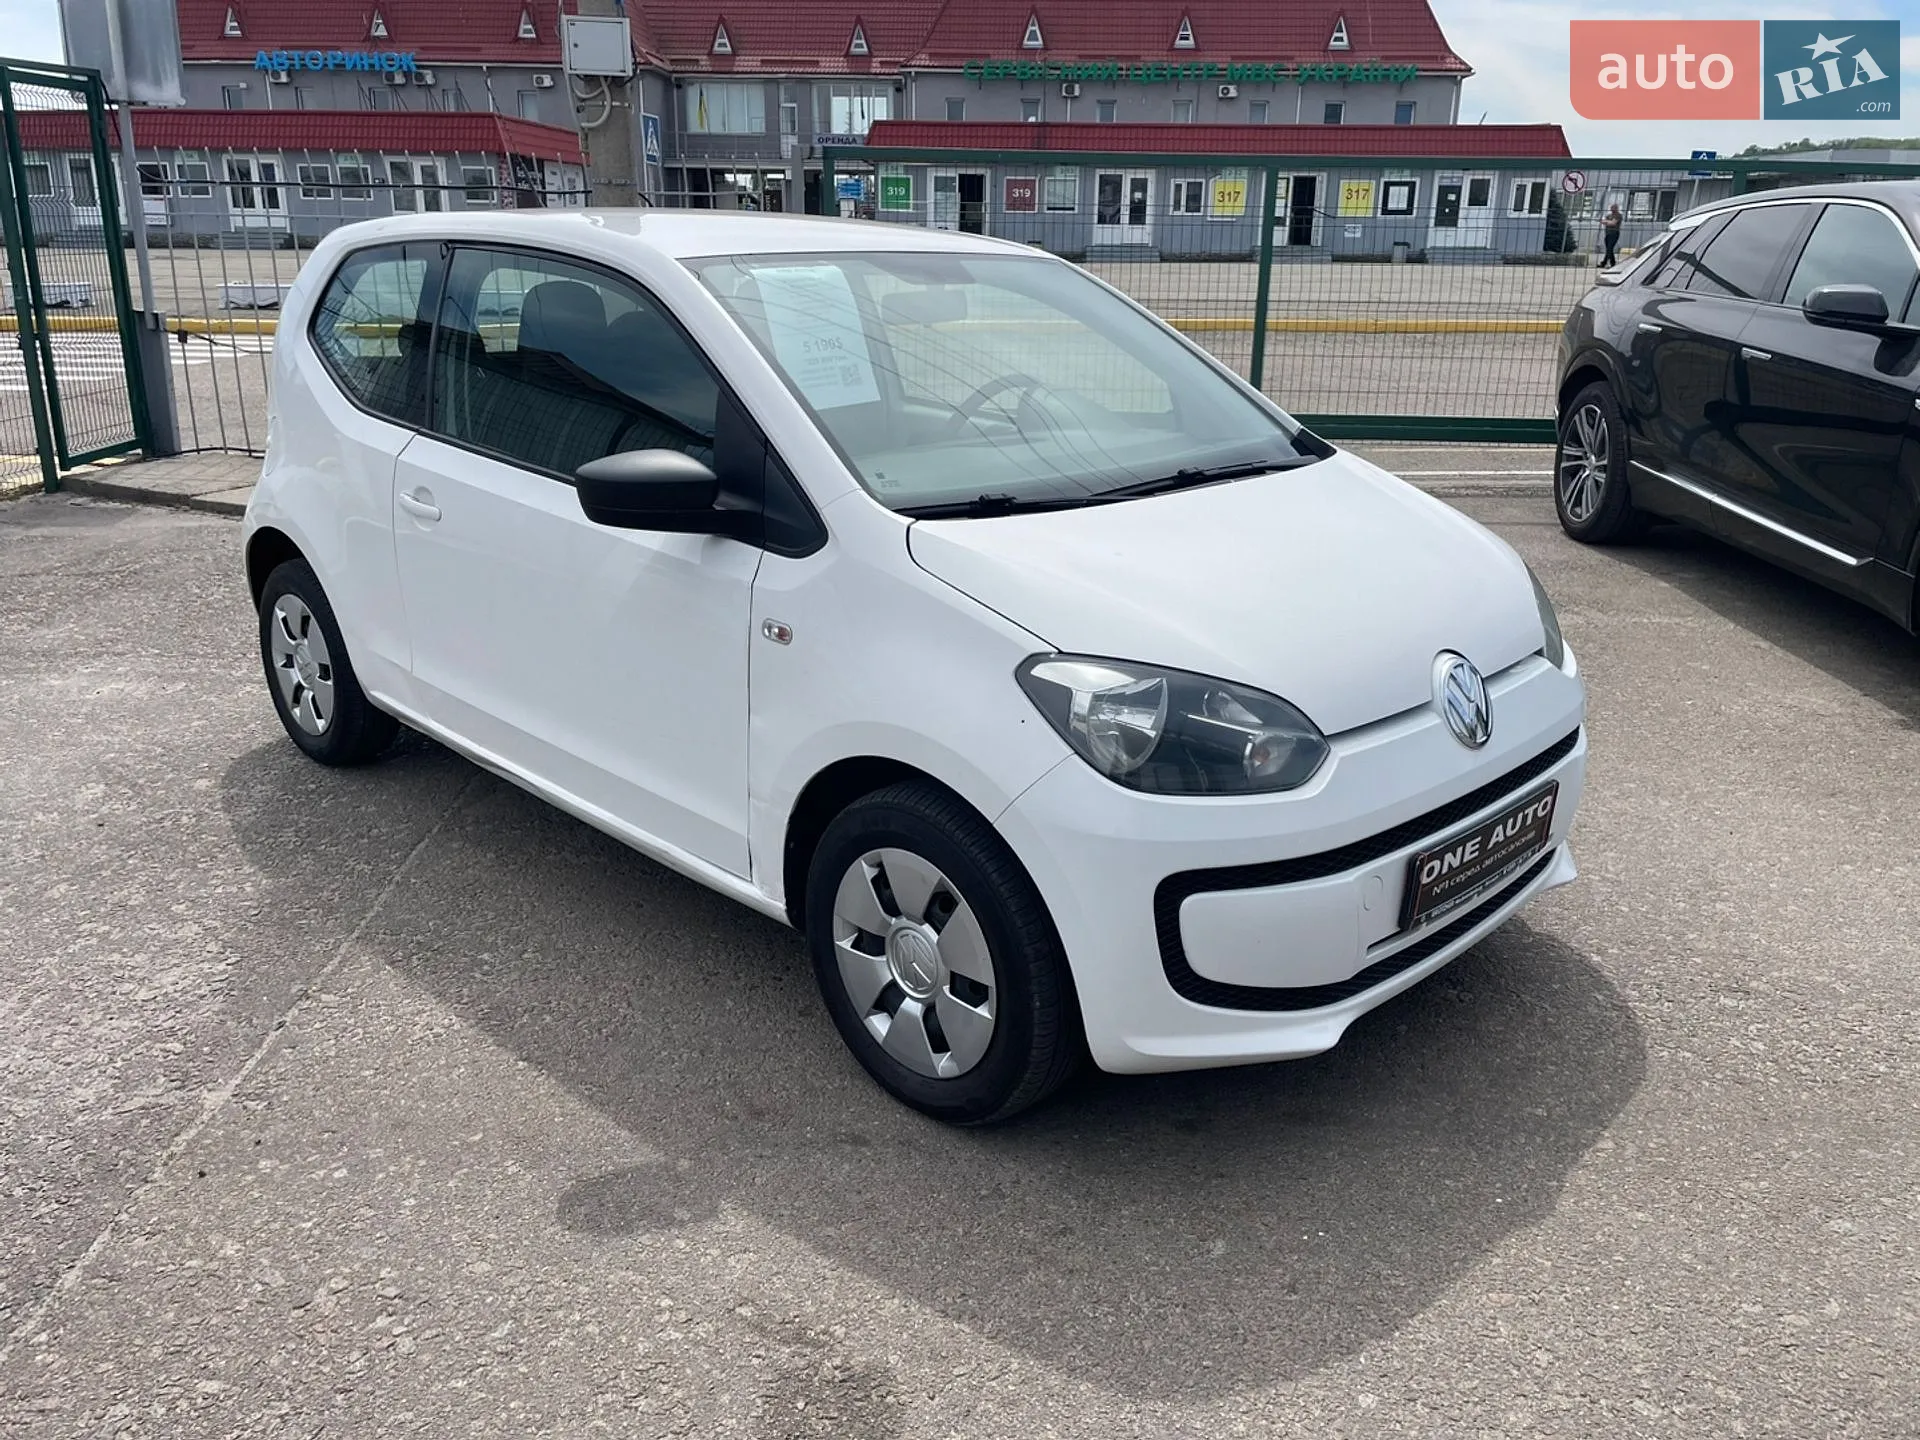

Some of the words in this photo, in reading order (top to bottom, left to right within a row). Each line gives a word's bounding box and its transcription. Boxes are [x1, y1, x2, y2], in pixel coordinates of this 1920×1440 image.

[254, 49, 417, 72] АВТОРИНОК
[963, 59, 1119, 81] СЕРВІСНИЙ
[1130, 62, 1218, 84] ЦЕНТР
[1226, 63, 1286, 82] МВС
[1297, 62, 1418, 83] УКРАЇНИ
[817, 136, 858, 146] ОРЕНДА
[887, 186, 905, 196] 319
[1012, 188, 1031, 198] 319
[1217, 191, 1241, 203] 317
[1346, 188, 1370, 201] 317
[803, 340, 811, 353] 5
[1420, 836, 1482, 885] ONE
[1487, 795, 1553, 850] AUTO
